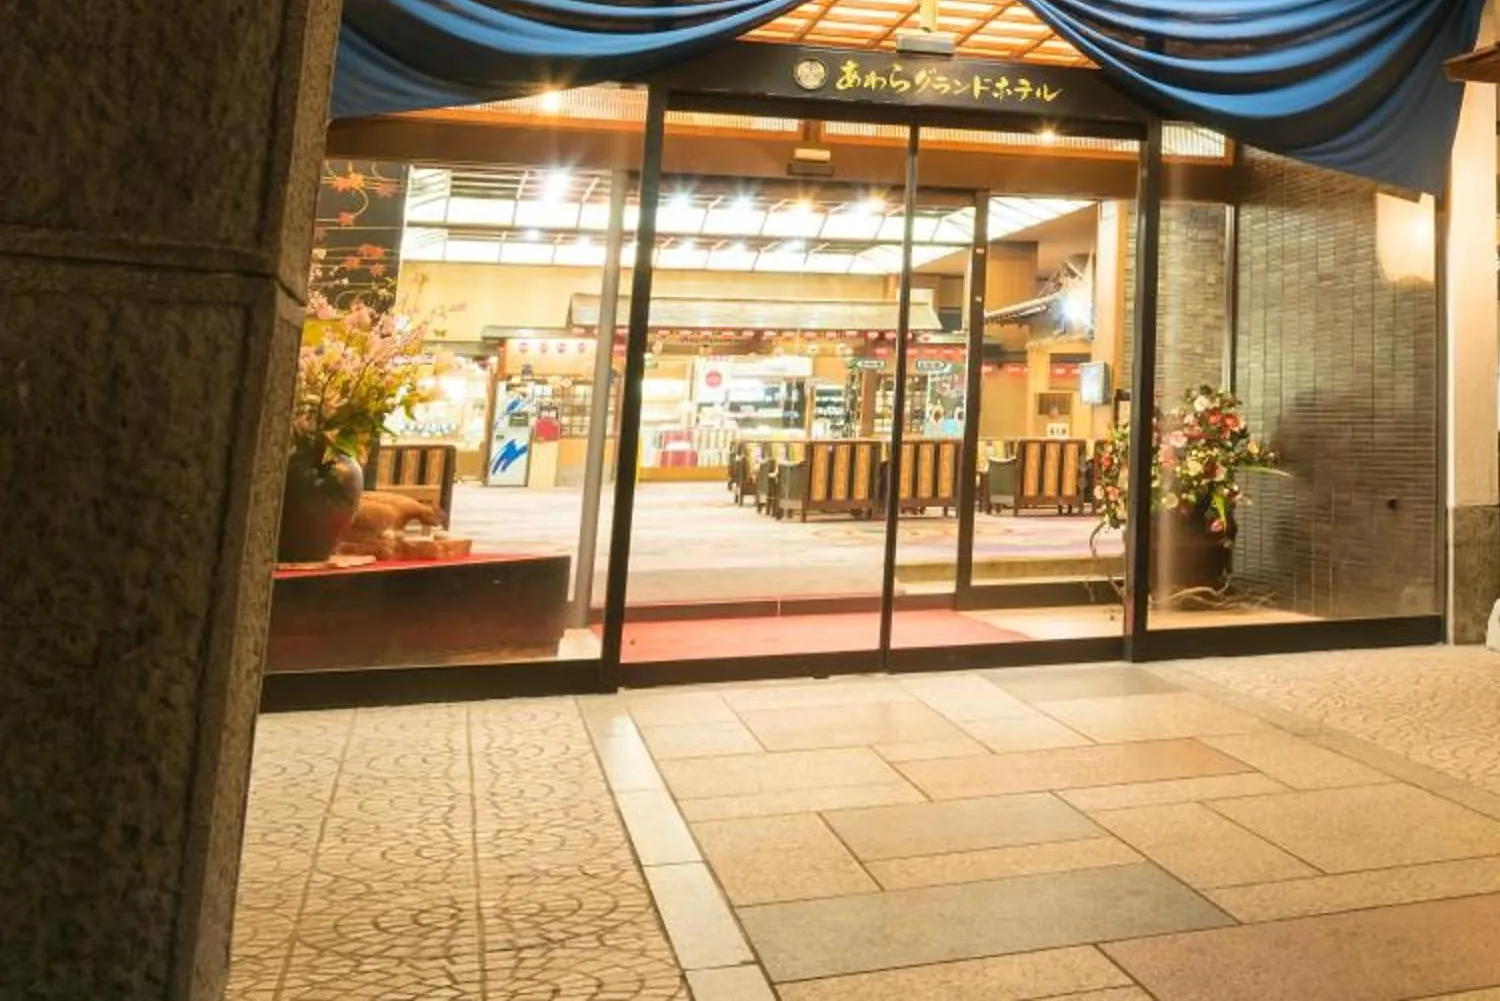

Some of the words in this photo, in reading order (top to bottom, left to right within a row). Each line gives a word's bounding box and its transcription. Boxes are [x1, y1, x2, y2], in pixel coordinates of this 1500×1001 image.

[836, 60, 1062, 102] あわらグランドホテル
